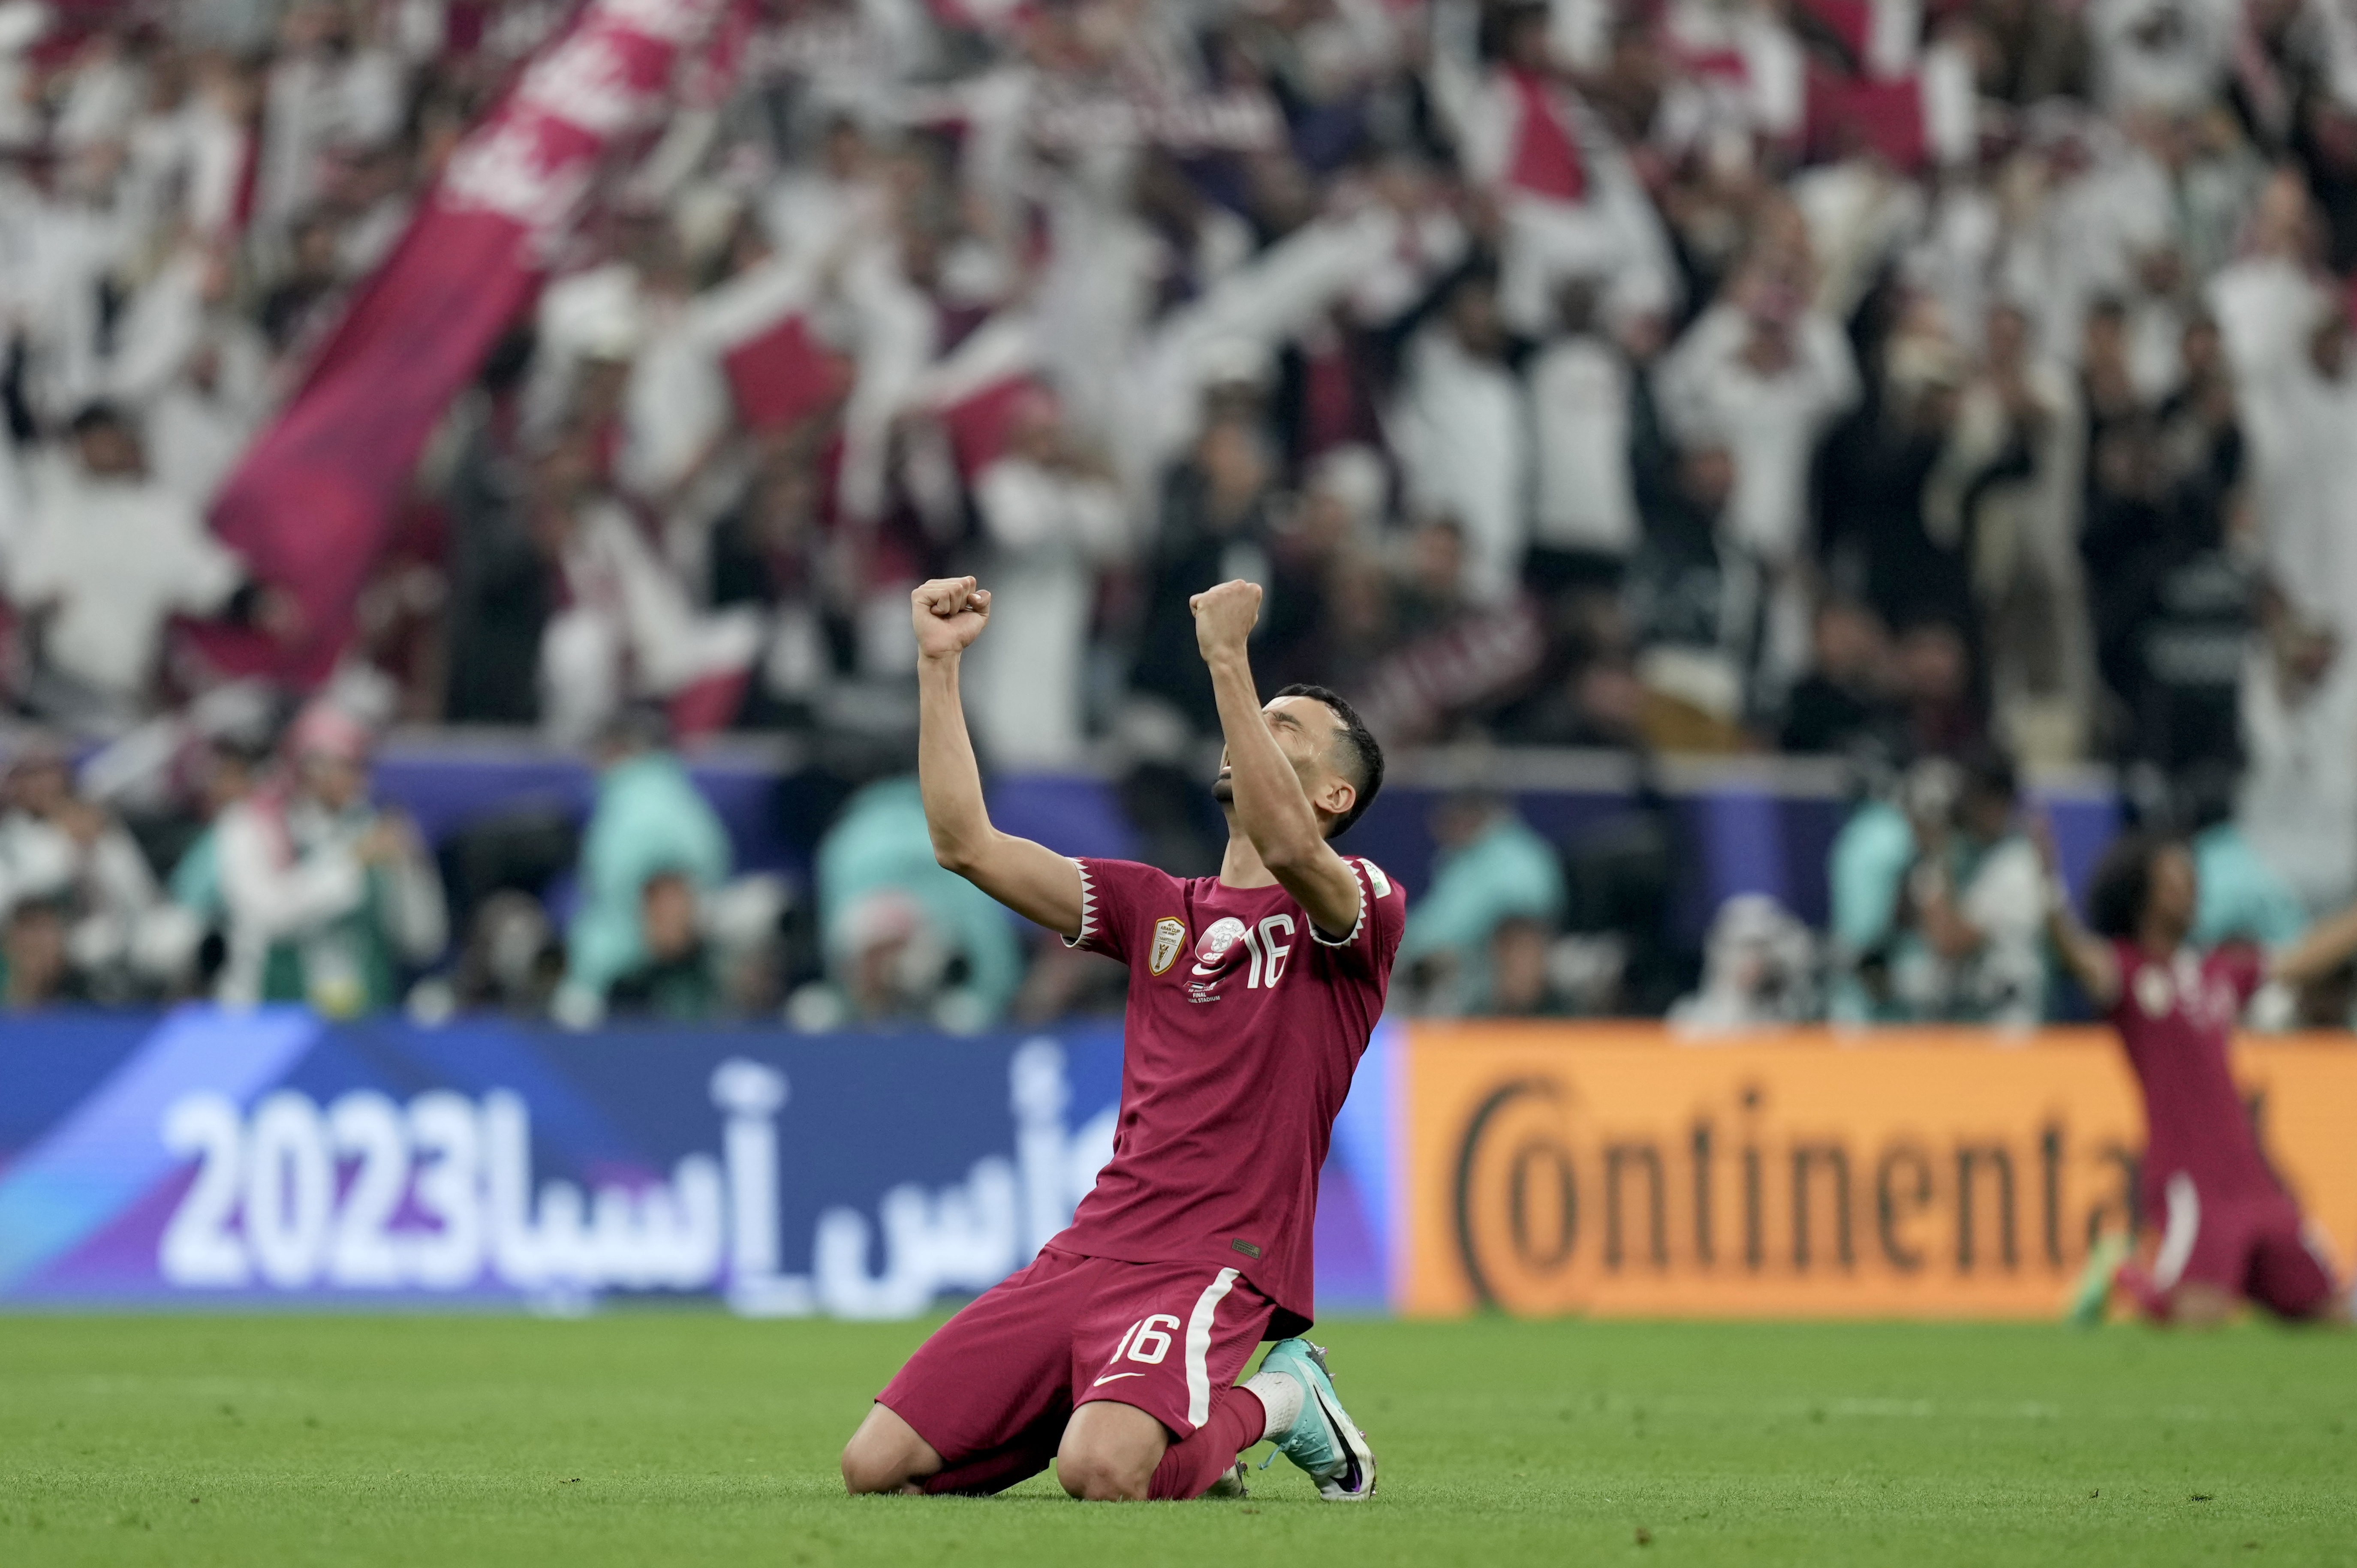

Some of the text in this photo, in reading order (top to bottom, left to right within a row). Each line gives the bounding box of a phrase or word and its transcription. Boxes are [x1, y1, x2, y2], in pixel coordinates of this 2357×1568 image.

[1157, 935, 1176, 943] CHAMPIONS
[1239, 913, 1295, 988] 16
[160, 1091, 477, 1285] 2023
[1453, 1075, 2144, 1312] Continenta
[1110, 1314, 1181, 1364] 16
